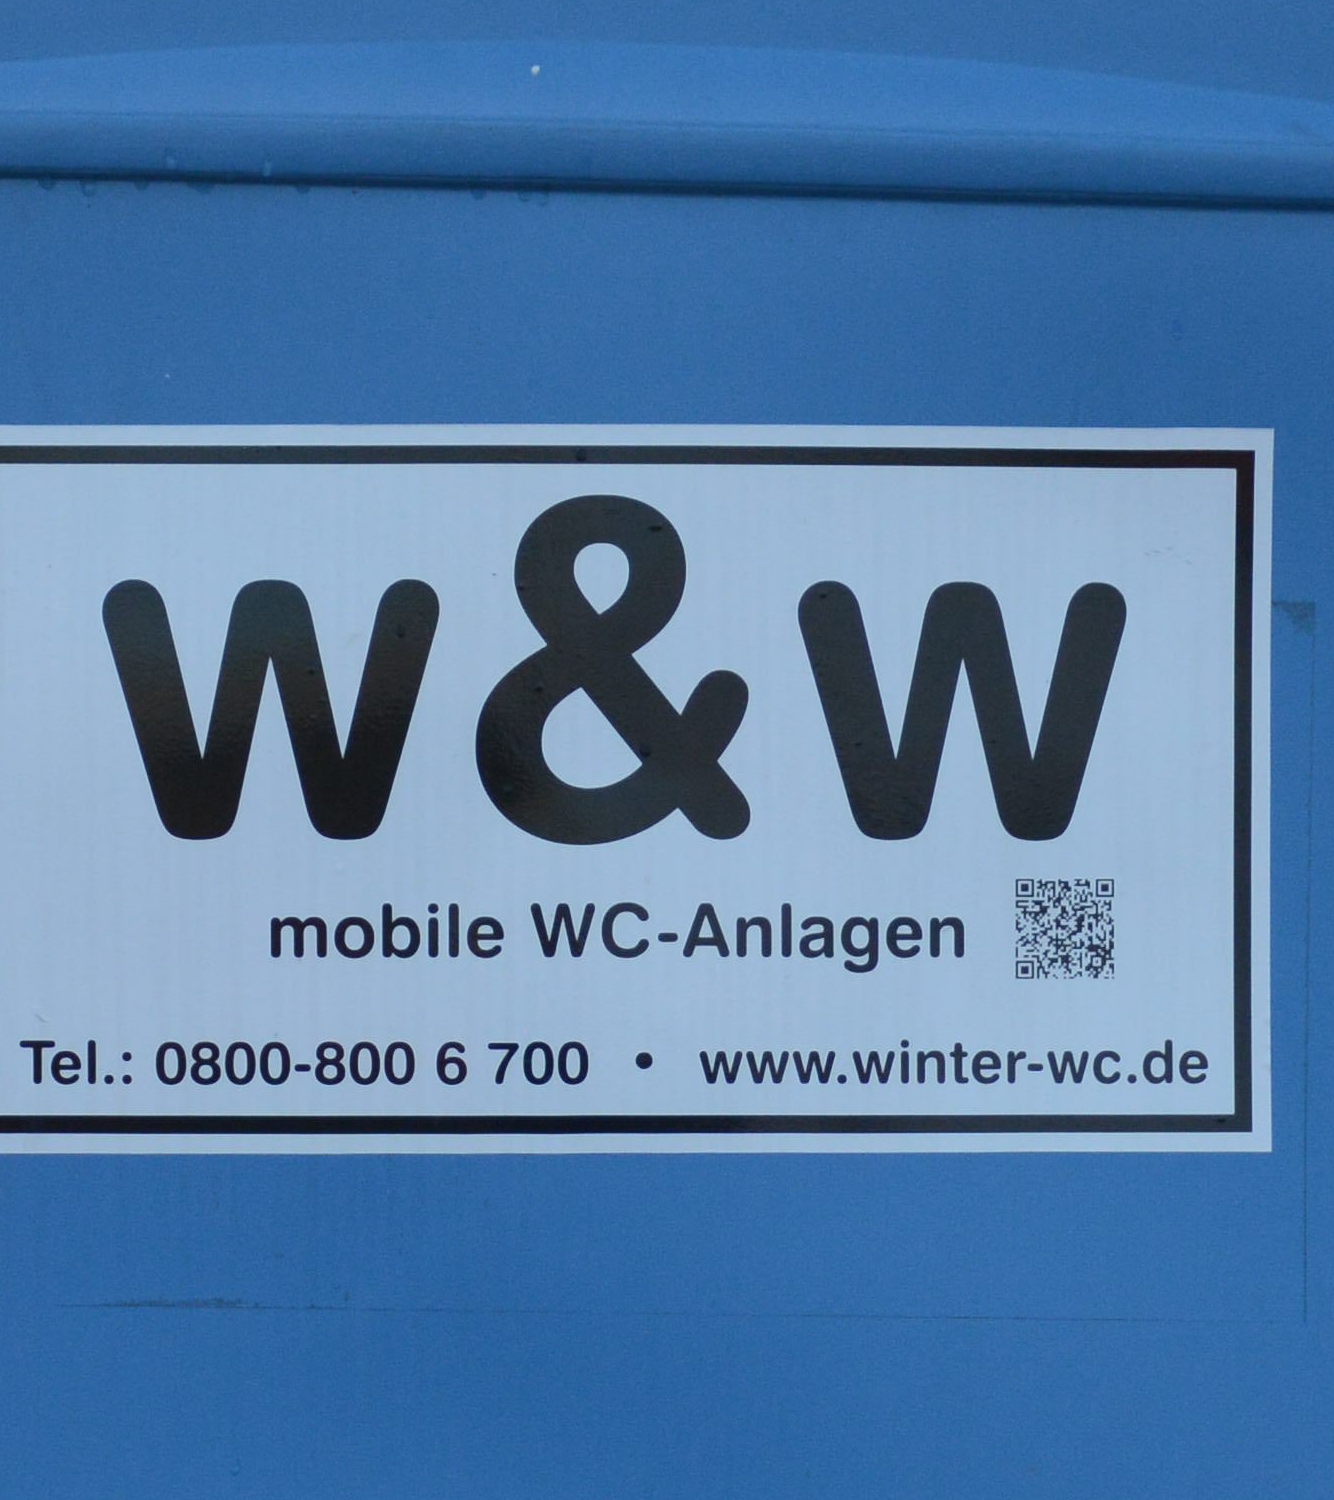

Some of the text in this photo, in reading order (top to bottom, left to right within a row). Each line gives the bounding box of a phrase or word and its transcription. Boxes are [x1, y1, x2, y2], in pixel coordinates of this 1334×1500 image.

[101, 494, 1128, 846] W&W
[269, 901, 966, 975] mobile WC-Anlagen
[18, 1038, 1210, 1087] Tel.: 0800-800 6 700 www.winter-wc.de
